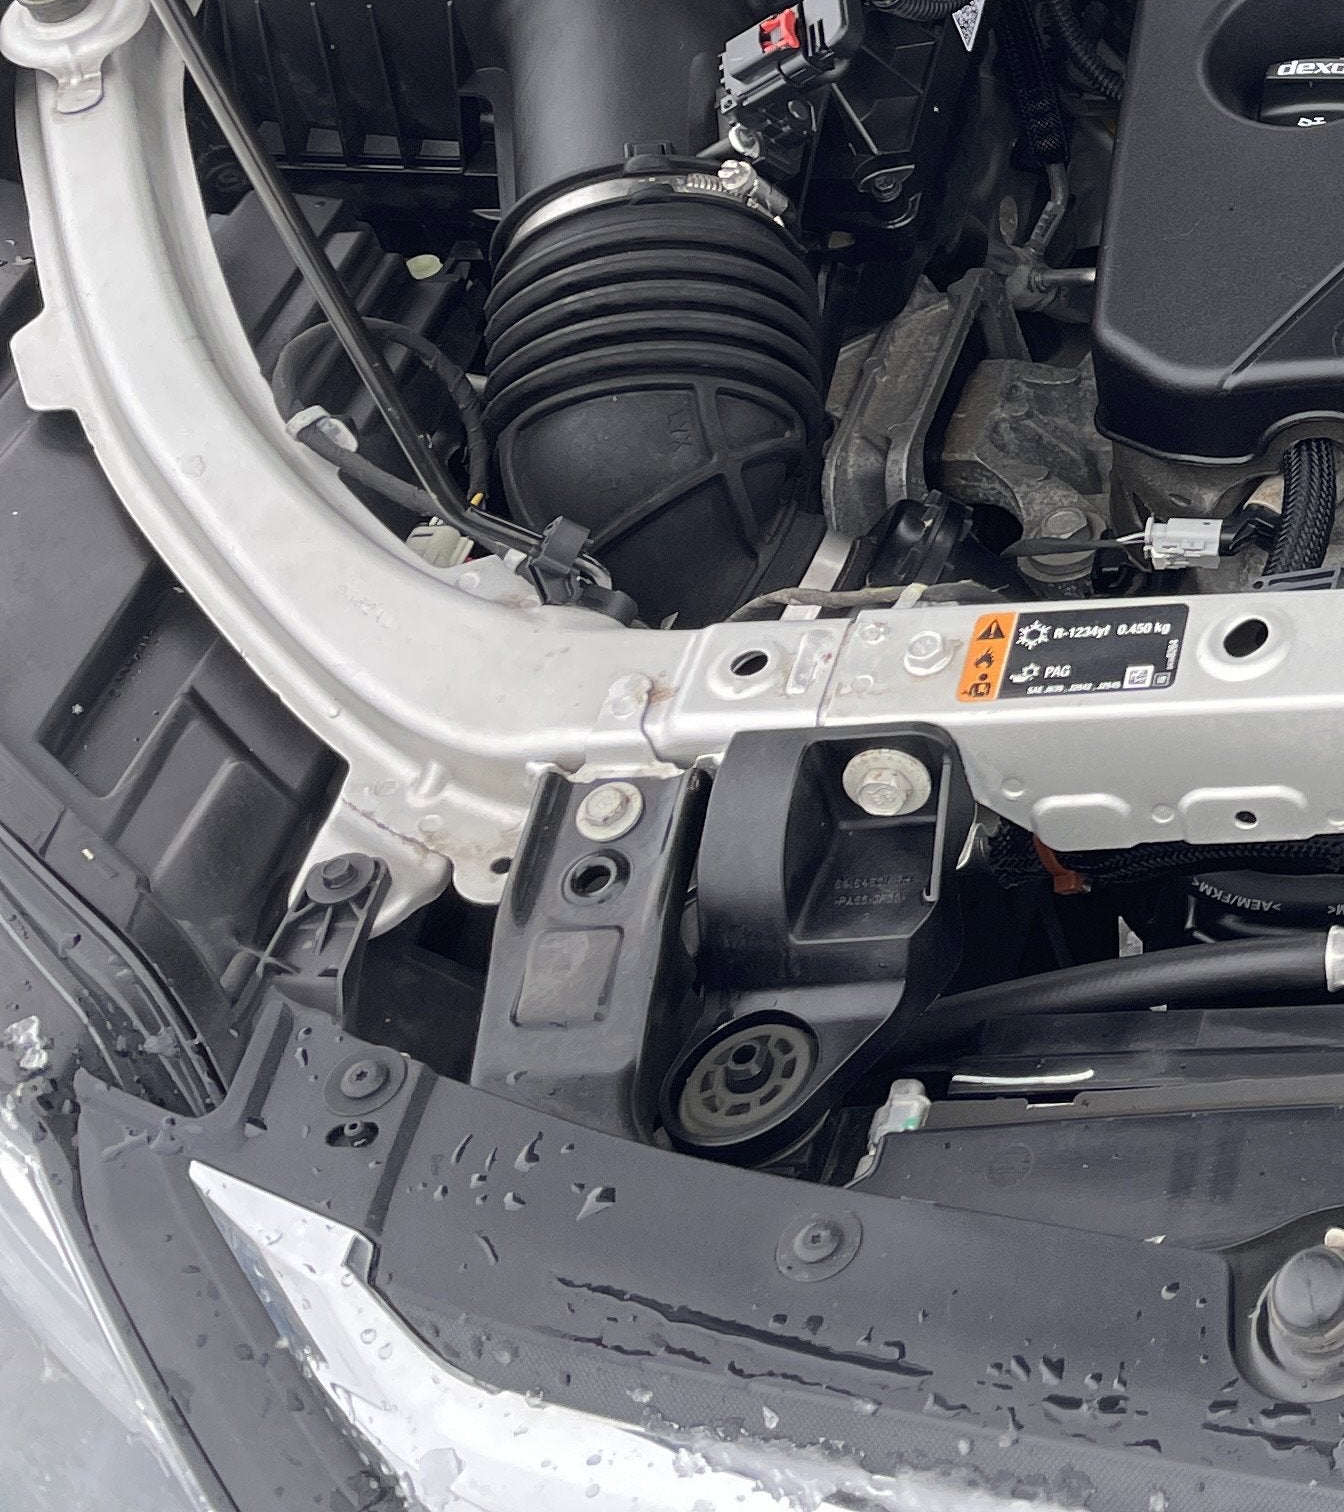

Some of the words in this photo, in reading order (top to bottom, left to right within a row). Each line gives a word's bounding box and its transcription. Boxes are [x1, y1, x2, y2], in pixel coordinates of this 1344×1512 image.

[1053, 624, 1111, 640] R-1234yf
[1116, 622, 1153, 636] 0.450
[1153, 621, 1171, 635] kg
[1043, 664, 1072, 679] PAG
